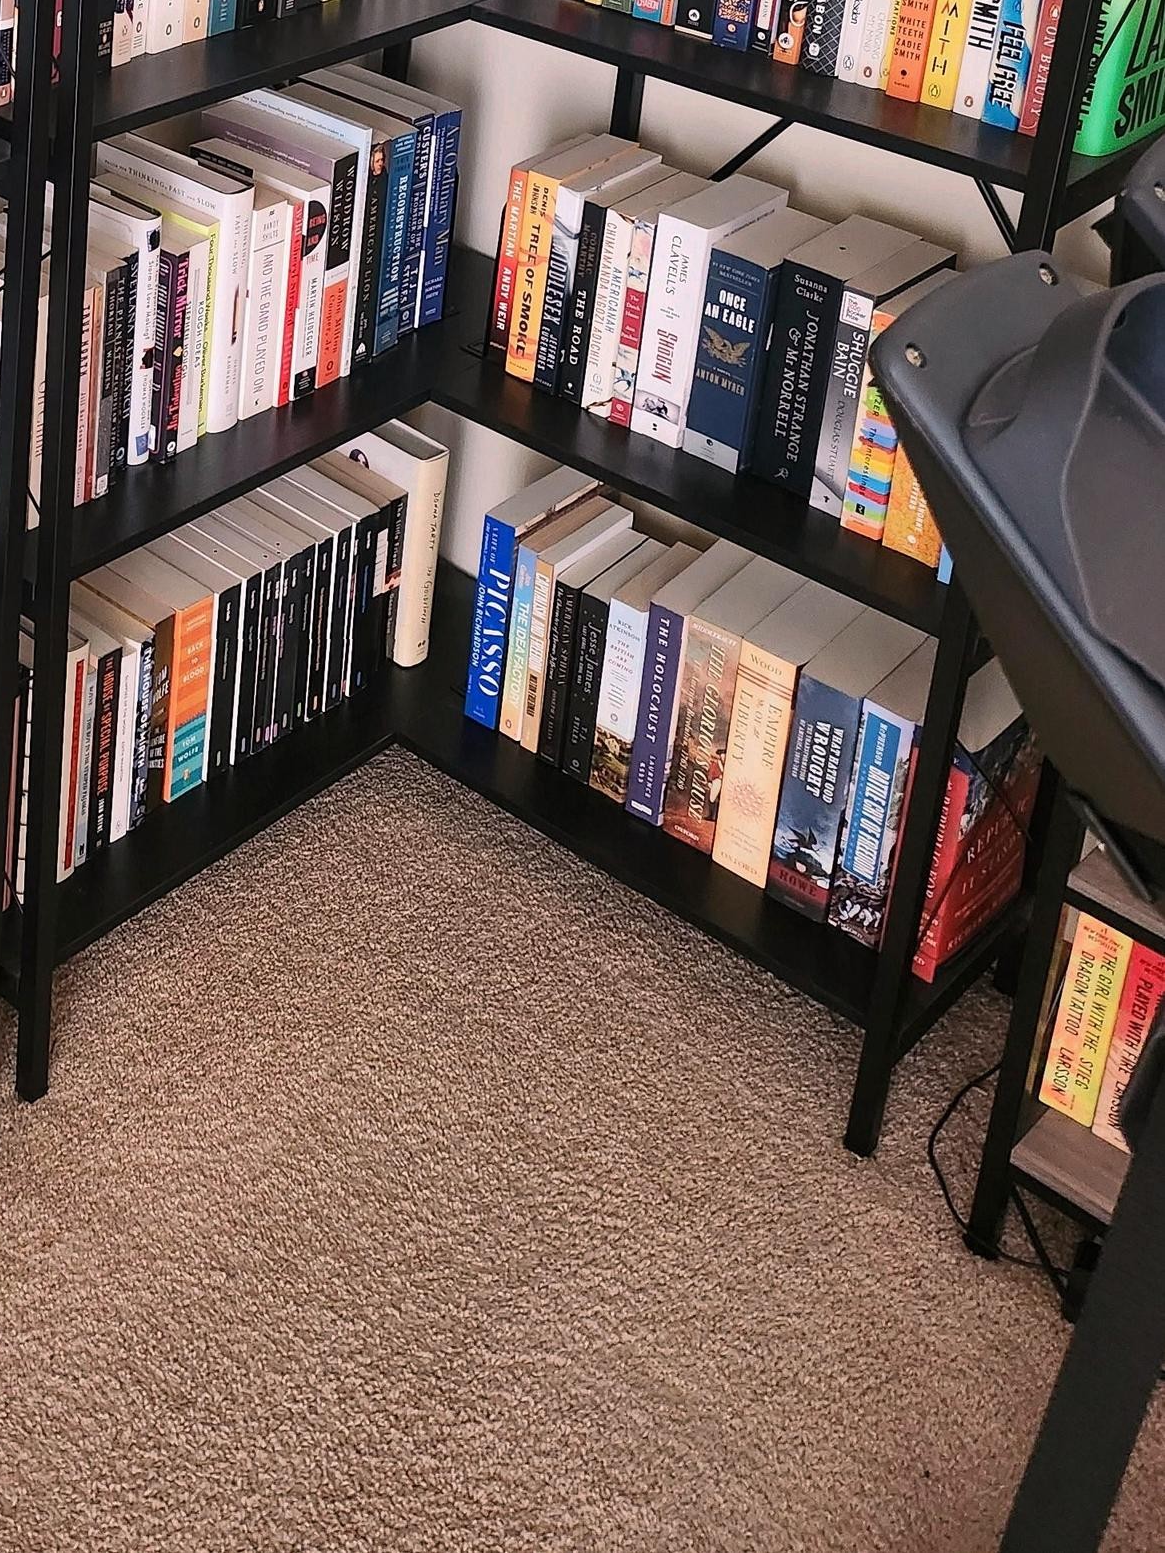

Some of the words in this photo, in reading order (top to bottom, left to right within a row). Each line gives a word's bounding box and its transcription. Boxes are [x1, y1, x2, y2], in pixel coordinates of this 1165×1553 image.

[512, 180, 523, 202] THE
[505, 207, 520, 258] MARTIAN
[501, 267, 512, 297] ANDY
[496, 302, 508, 331] WEIR
[719, 289, 746, 312] ONCE
[705, 304, 719, 320] AN
[721, 308, 755, 334] EAGLE
[797, 310, 820, 390] JONATHAN
[833, 341, 847, 380] BAIN
[843, 330, 865, 399] SHUGGIE
[786, 392, 807, 463] STRANGE
[477, 582, 486, 609] JOHN
[471, 610, 485, 667] RICHARDSON
[481, 568, 511, 696] PICASSO
[659, 617, 671, 648] THE
[648, 653, 667, 743] HOLOCAUST
[1074, 951, 1095, 997] DRAGON
[1102, 951, 1117, 974] THE
[1096, 975, 1113, 998] GIRL
[1065, 999, 1086, 1036] TATTOO
[1090, 1002, 1108, 1036] WITH
[1083, 1036, 1098, 1053] THE
[1051, 1047, 1074, 1096] LARSSON
